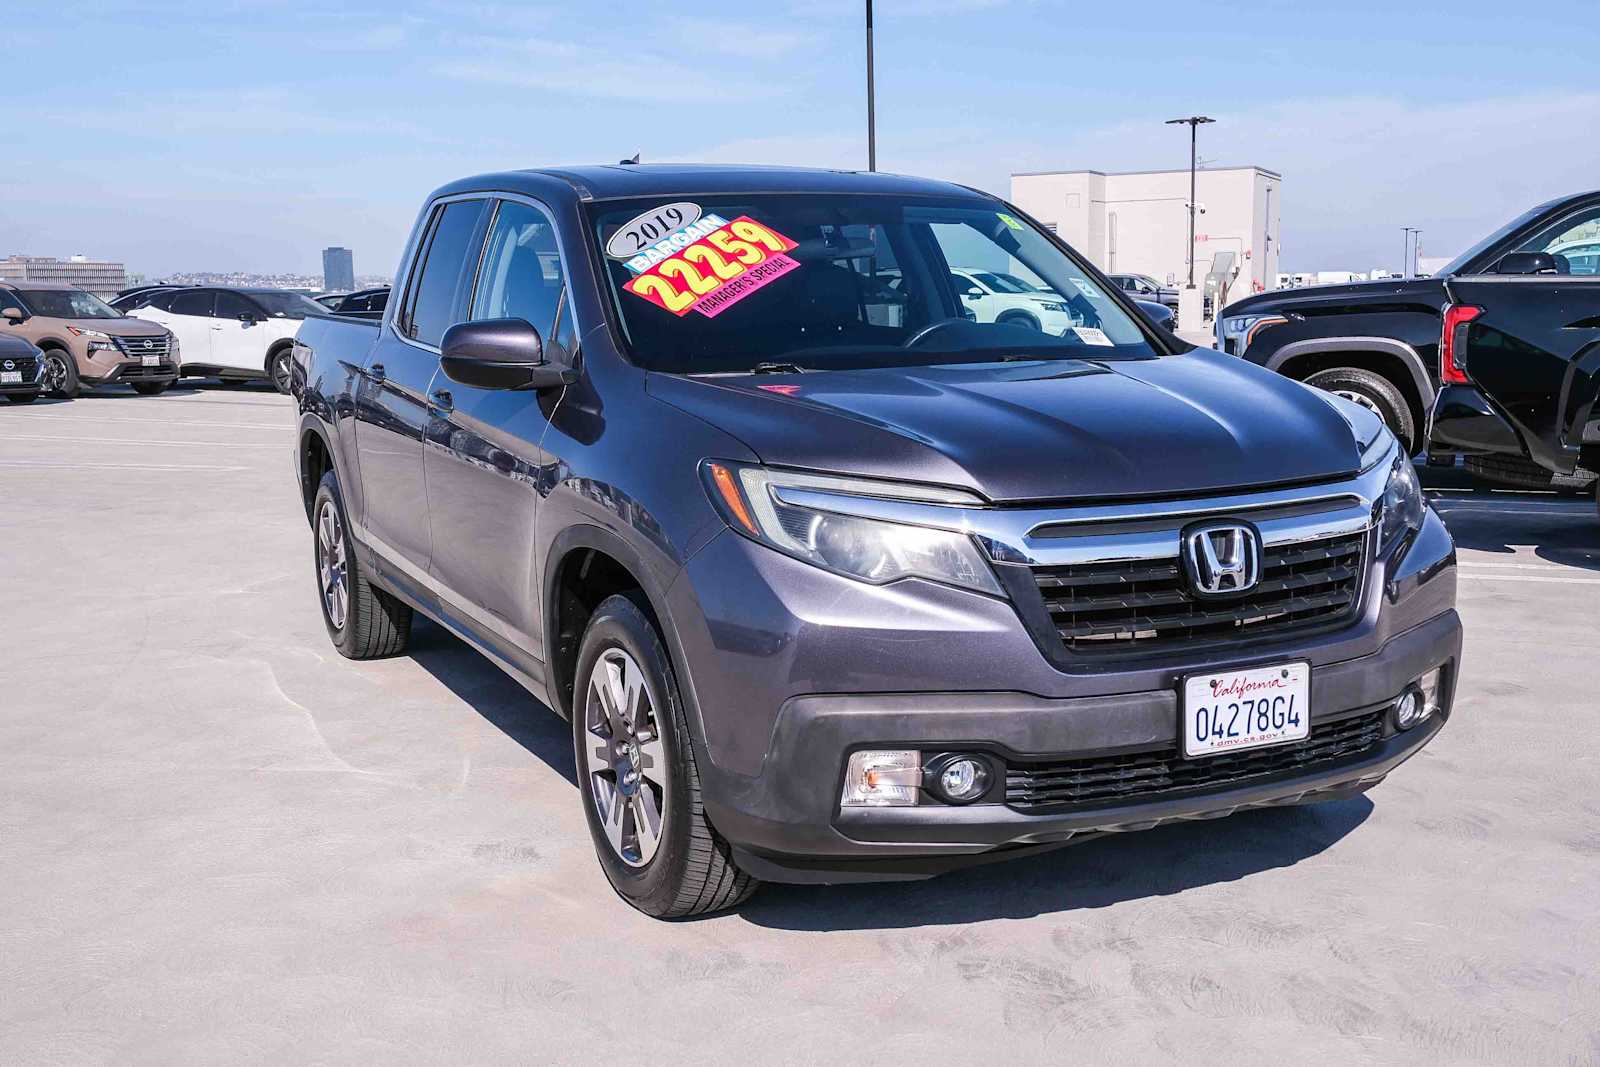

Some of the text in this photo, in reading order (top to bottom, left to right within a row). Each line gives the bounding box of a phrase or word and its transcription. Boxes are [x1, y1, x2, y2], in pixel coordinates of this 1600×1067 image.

[625, 207, 684, 251] 2019
[628, 213, 725, 274] BARGAIN
[632, 221, 788, 313] 22259
[698, 255, 791, 314] MANAGER'S SPECIAL
[1211, 676, 1288, 699] California
[1195, 694, 1300, 742] 04278G4
